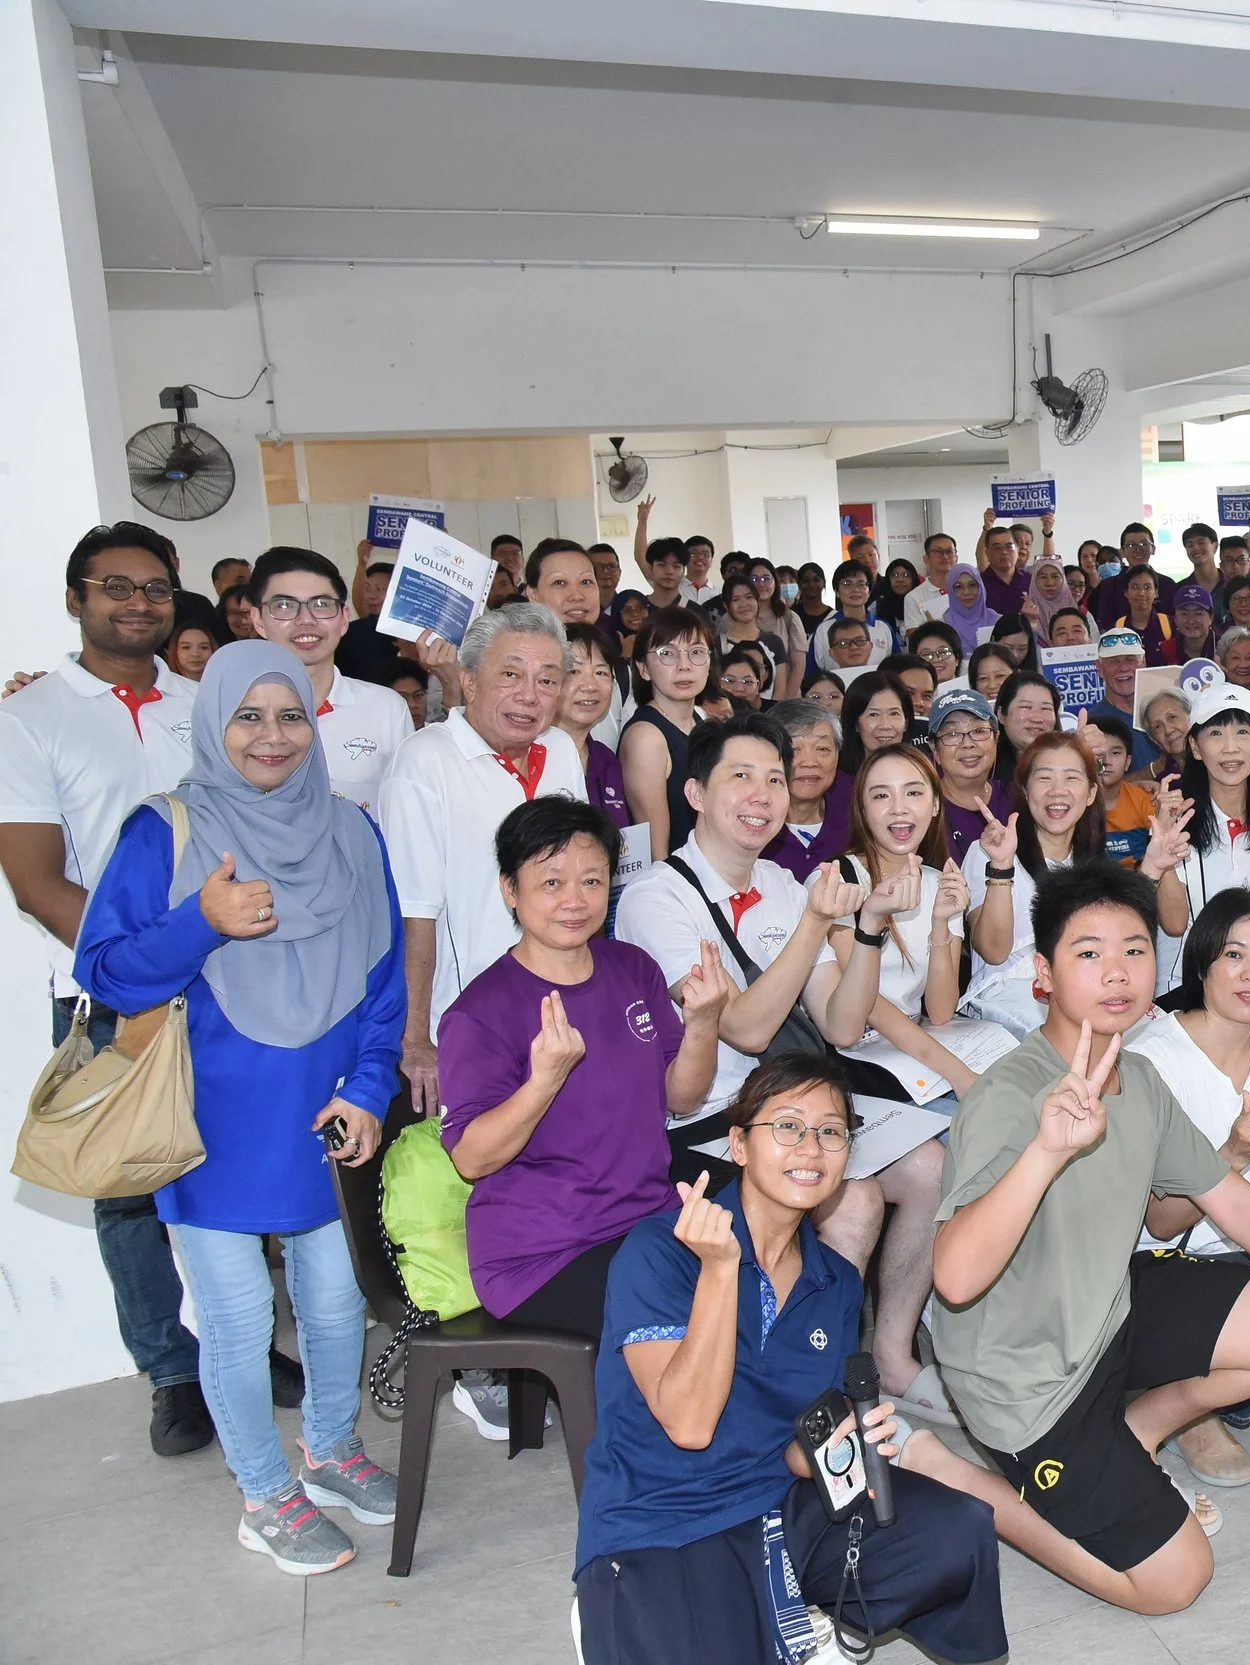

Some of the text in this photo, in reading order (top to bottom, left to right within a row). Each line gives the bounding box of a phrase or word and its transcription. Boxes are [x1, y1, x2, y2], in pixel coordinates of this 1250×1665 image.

[998, 488, 1050, 501] SENIOR
[998, 500, 1051, 511] PROFILING
[413, 552, 474, 590] VOLUNTEER
[1055, 671, 1106, 692] SENI
